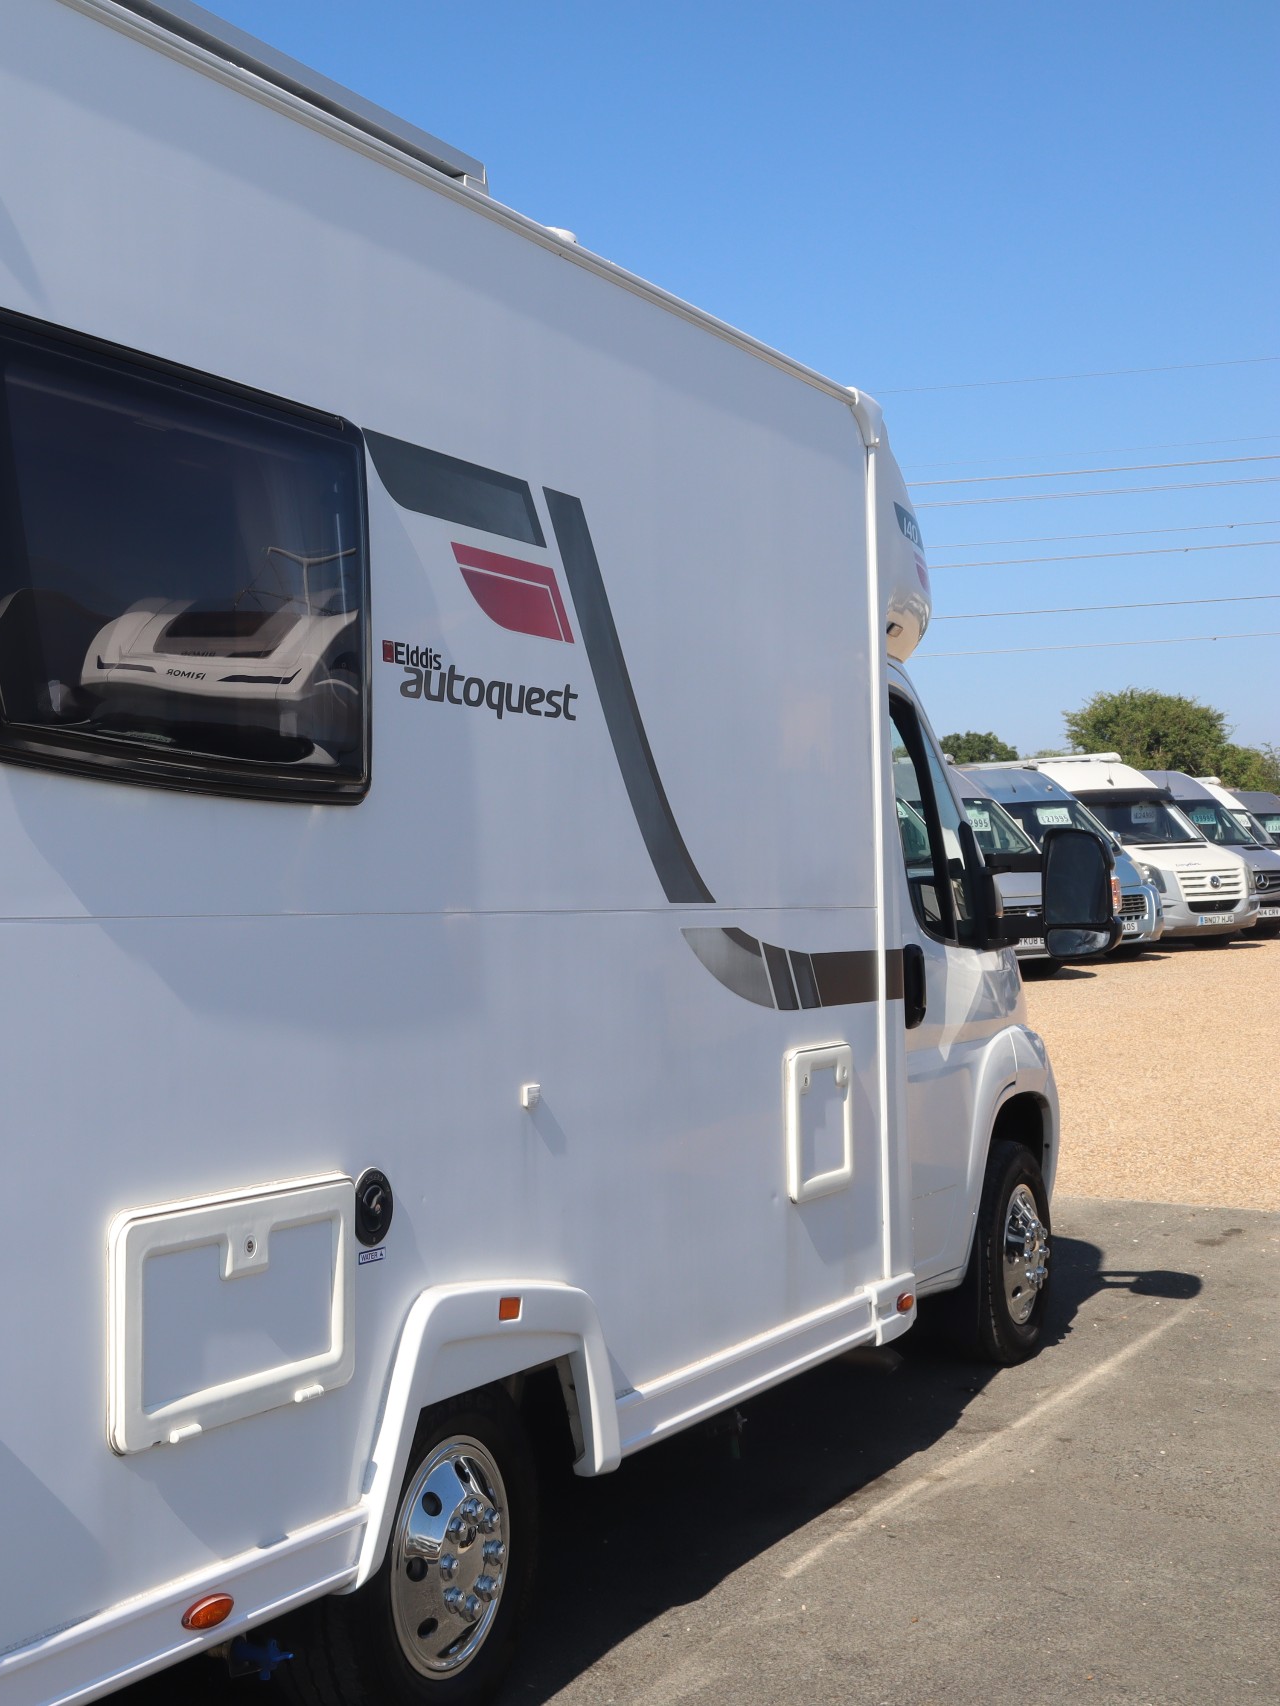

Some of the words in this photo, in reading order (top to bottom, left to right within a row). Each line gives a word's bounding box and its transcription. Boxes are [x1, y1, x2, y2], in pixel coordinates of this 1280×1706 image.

[903, 516, 919, 545] 140
[394, 641, 442, 671] Elddis
[399, 664, 579, 721] autoquest
[360, 1251, 378, 1262] WATER
